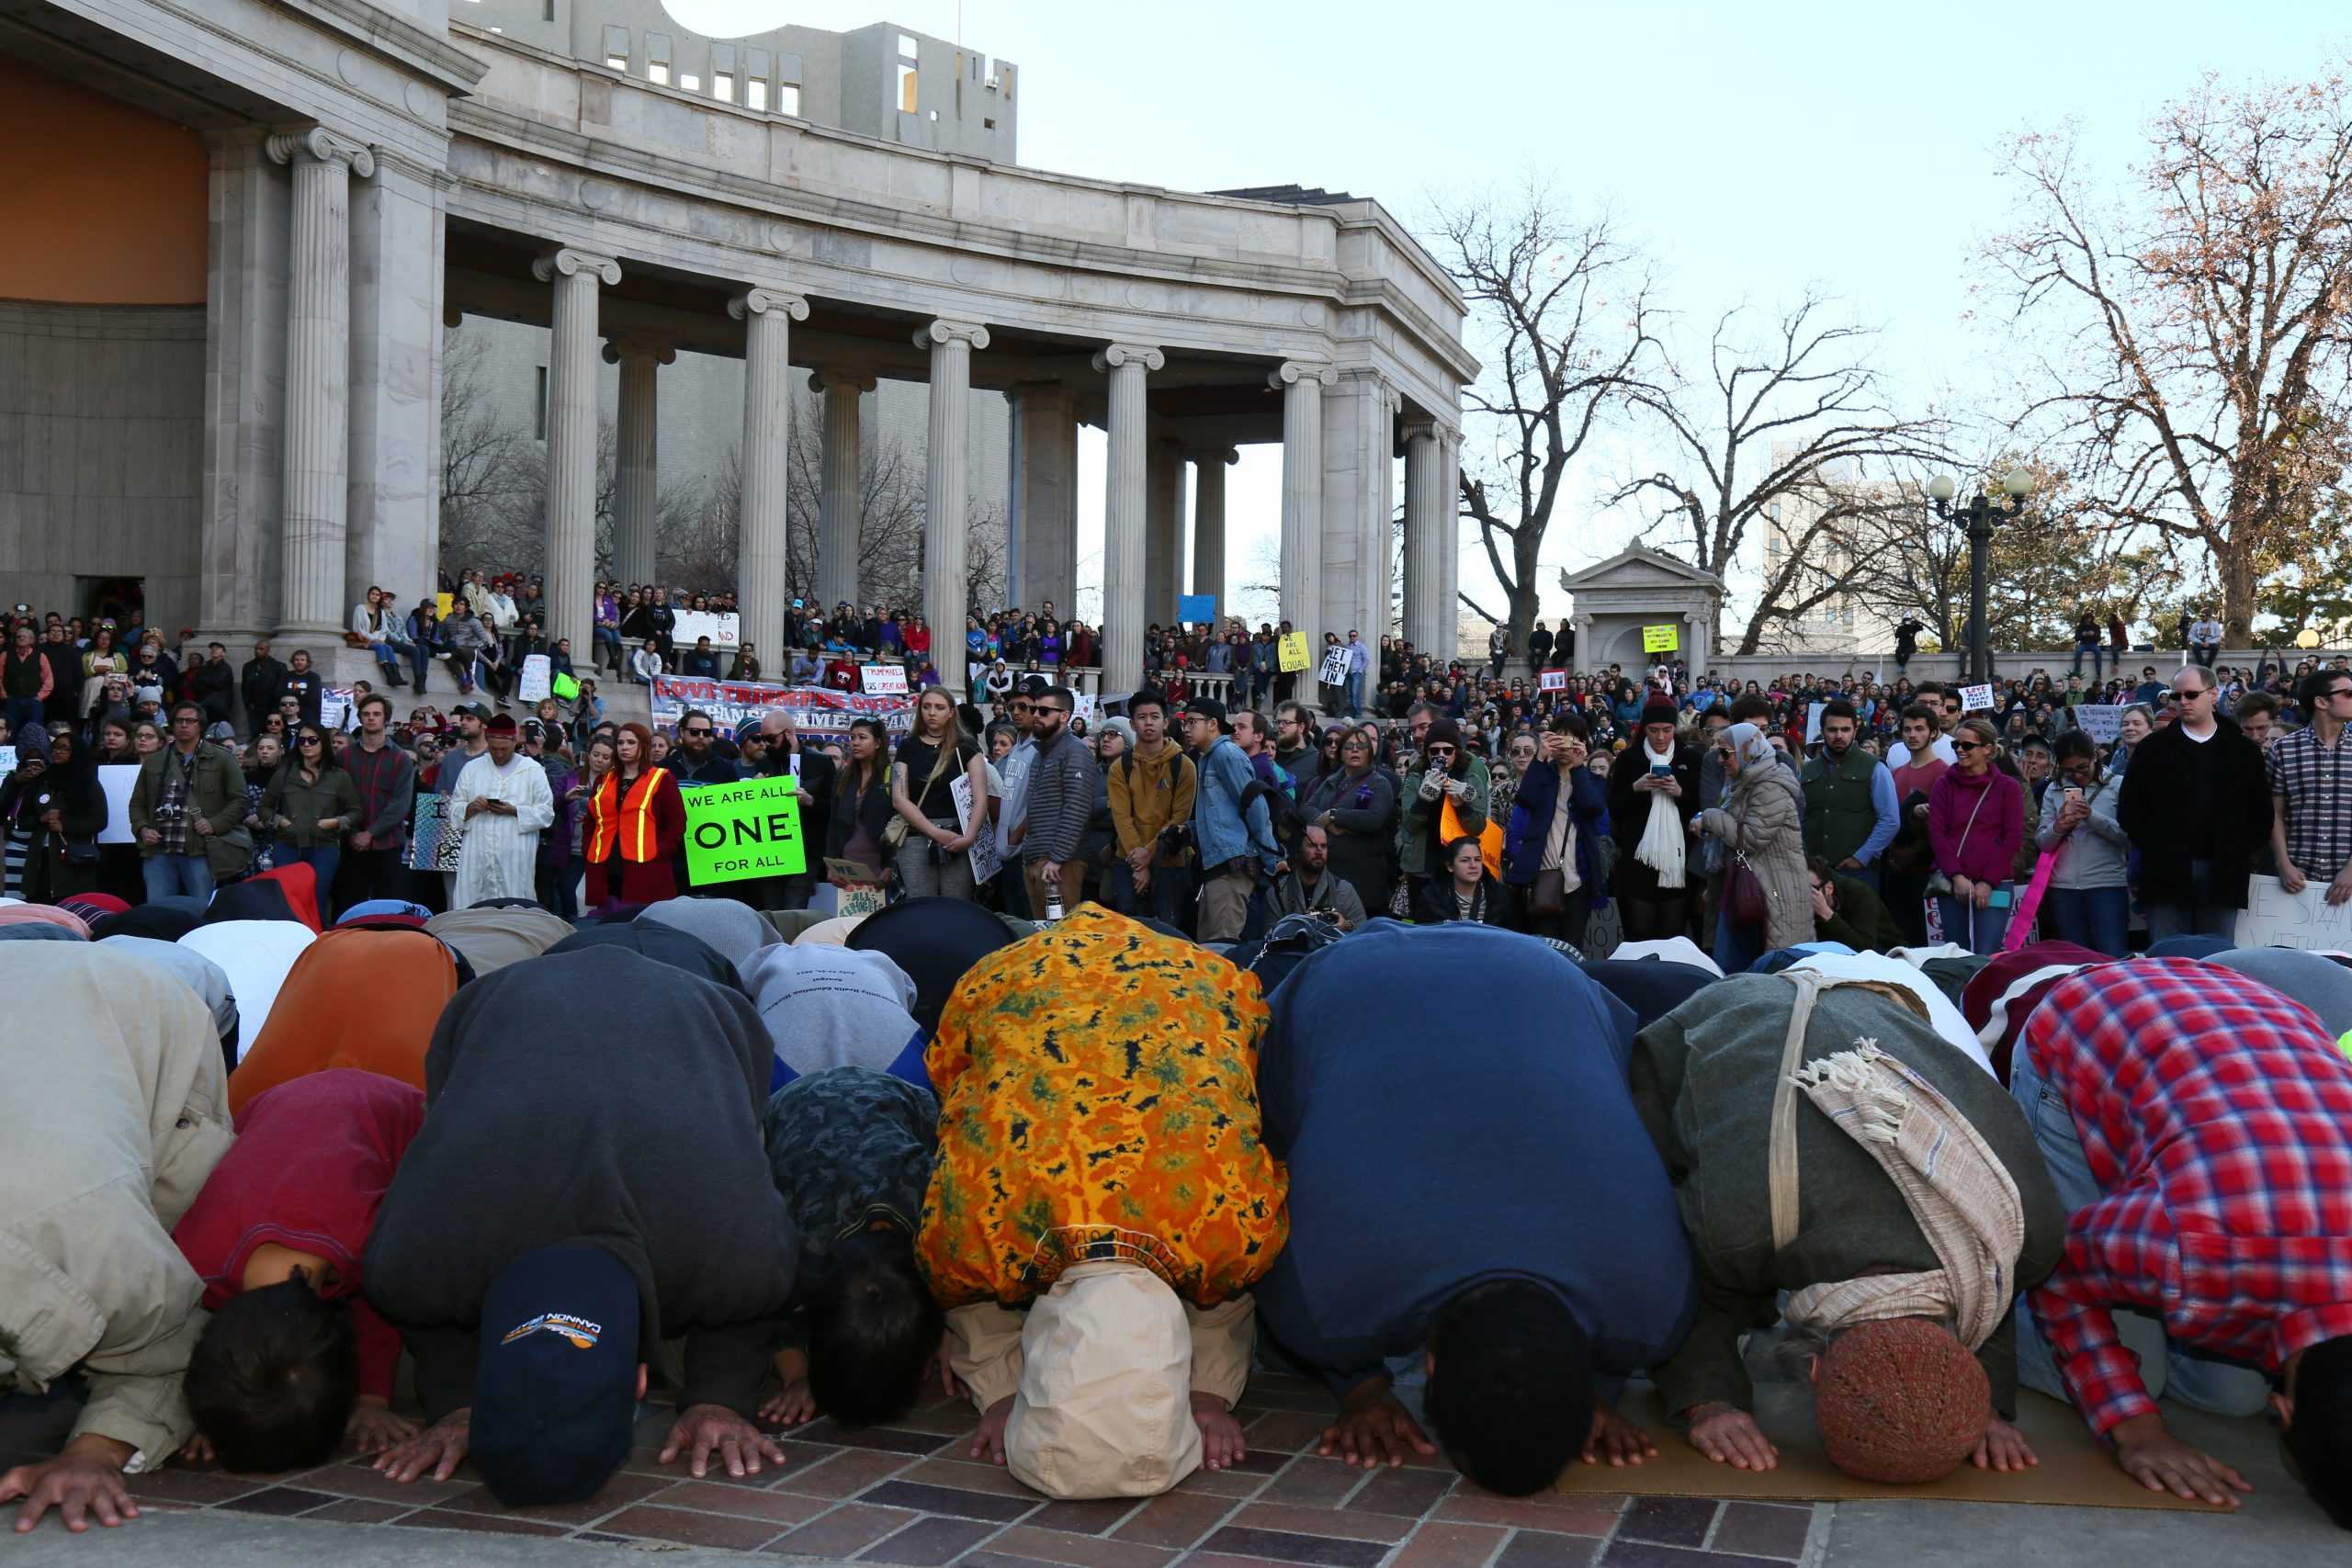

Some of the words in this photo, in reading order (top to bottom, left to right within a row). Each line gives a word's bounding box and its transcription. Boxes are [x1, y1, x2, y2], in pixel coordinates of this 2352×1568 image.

[1329, 646, 1347, 661] LET
[1282, 660, 1306, 671] EQUAL
[1323, 659, 1347, 675] THEM
[1325, 671, 1339, 684] IN
[656, 680, 718, 700] LOVE
[1965, 685, 1986, 694] LOVE
[1969, 700, 1988, 708] HATE
[687, 795, 716, 807] WE
[721, 790, 754, 804] ARE
[760, 785, 788, 798] ALL
[695, 812, 792, 850] ONE
[714, 859, 749, 873] FOR
[755, 855, 786, 868] ALL
[546, 1313, 602, 1334] CANNON
